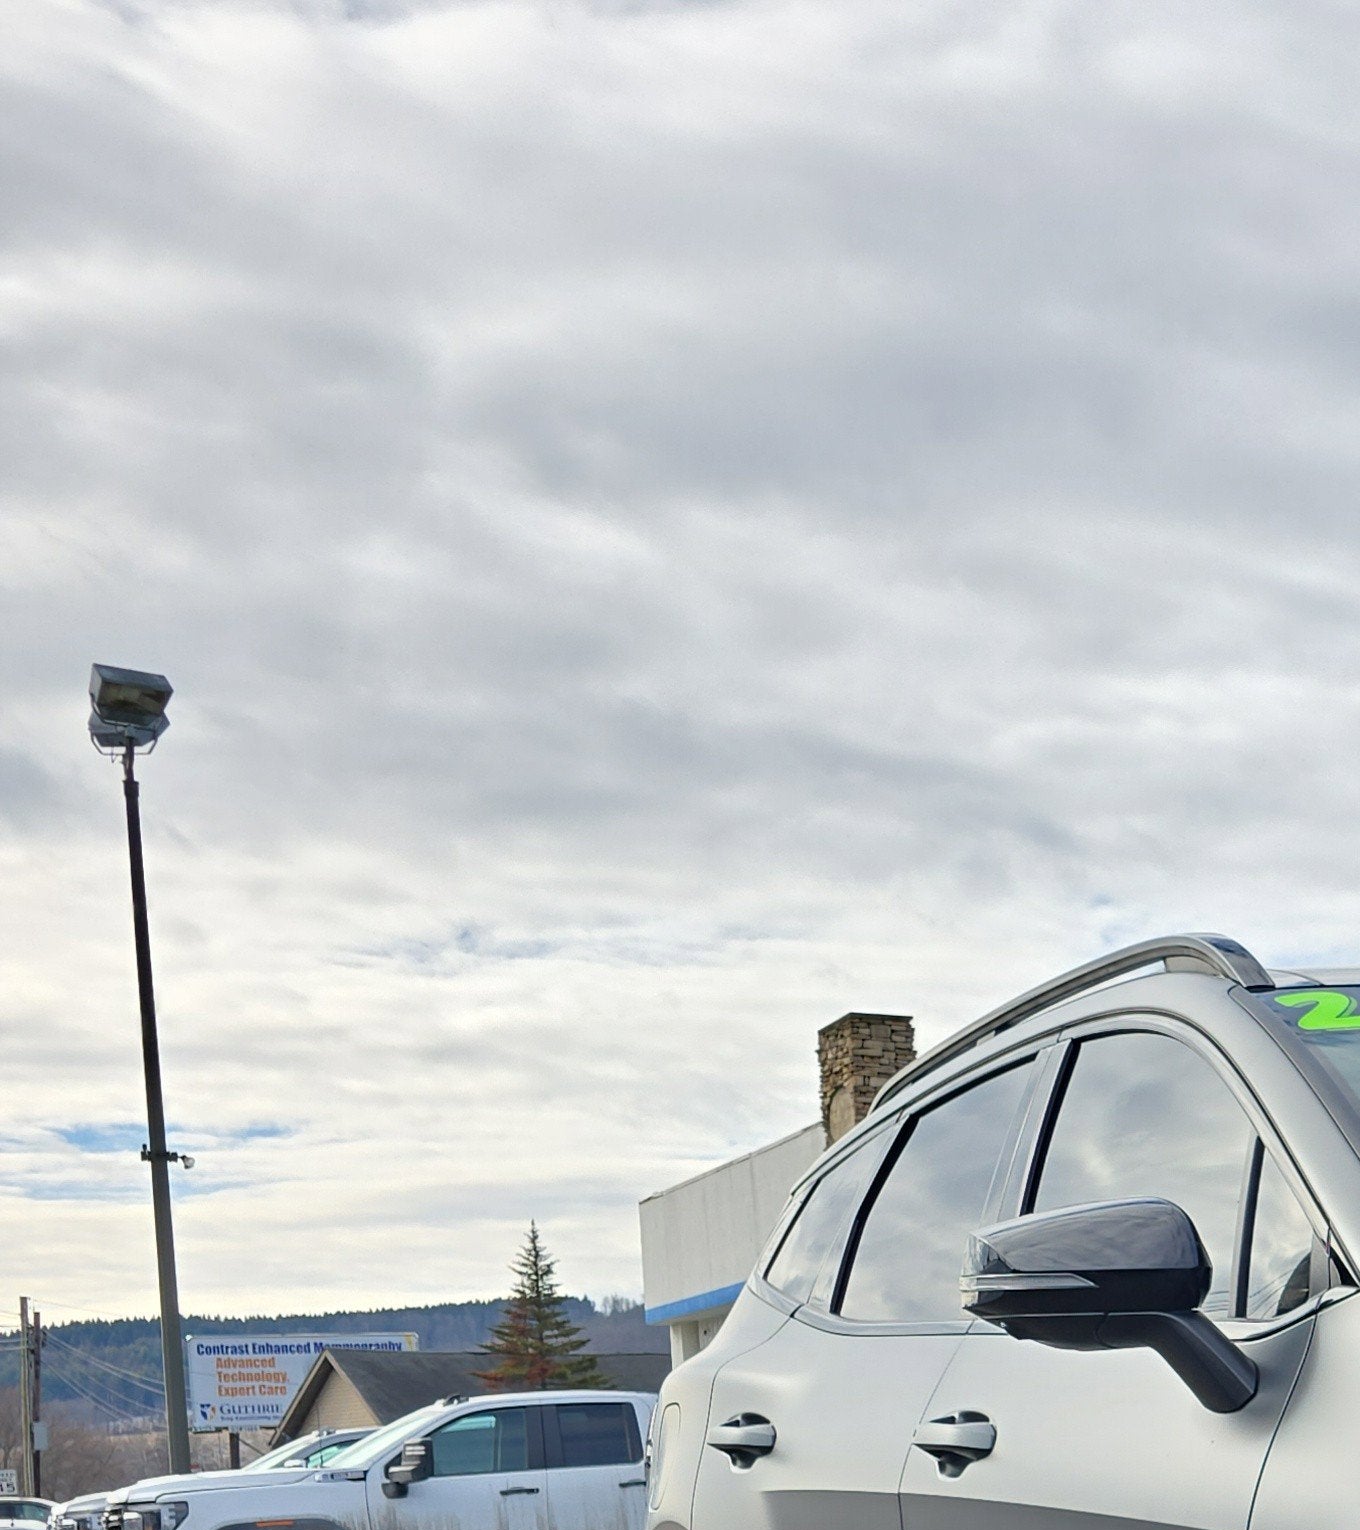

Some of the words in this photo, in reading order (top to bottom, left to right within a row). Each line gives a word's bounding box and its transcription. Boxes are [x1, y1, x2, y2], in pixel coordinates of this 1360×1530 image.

[197, 1343, 249, 1355] Contrast
[252, 1342, 311, 1355] Enhanced
[216, 1357, 276, 1368] Advanced
[218, 1385, 256, 1397] Expert
[259, 1384, 287, 1396] Care
